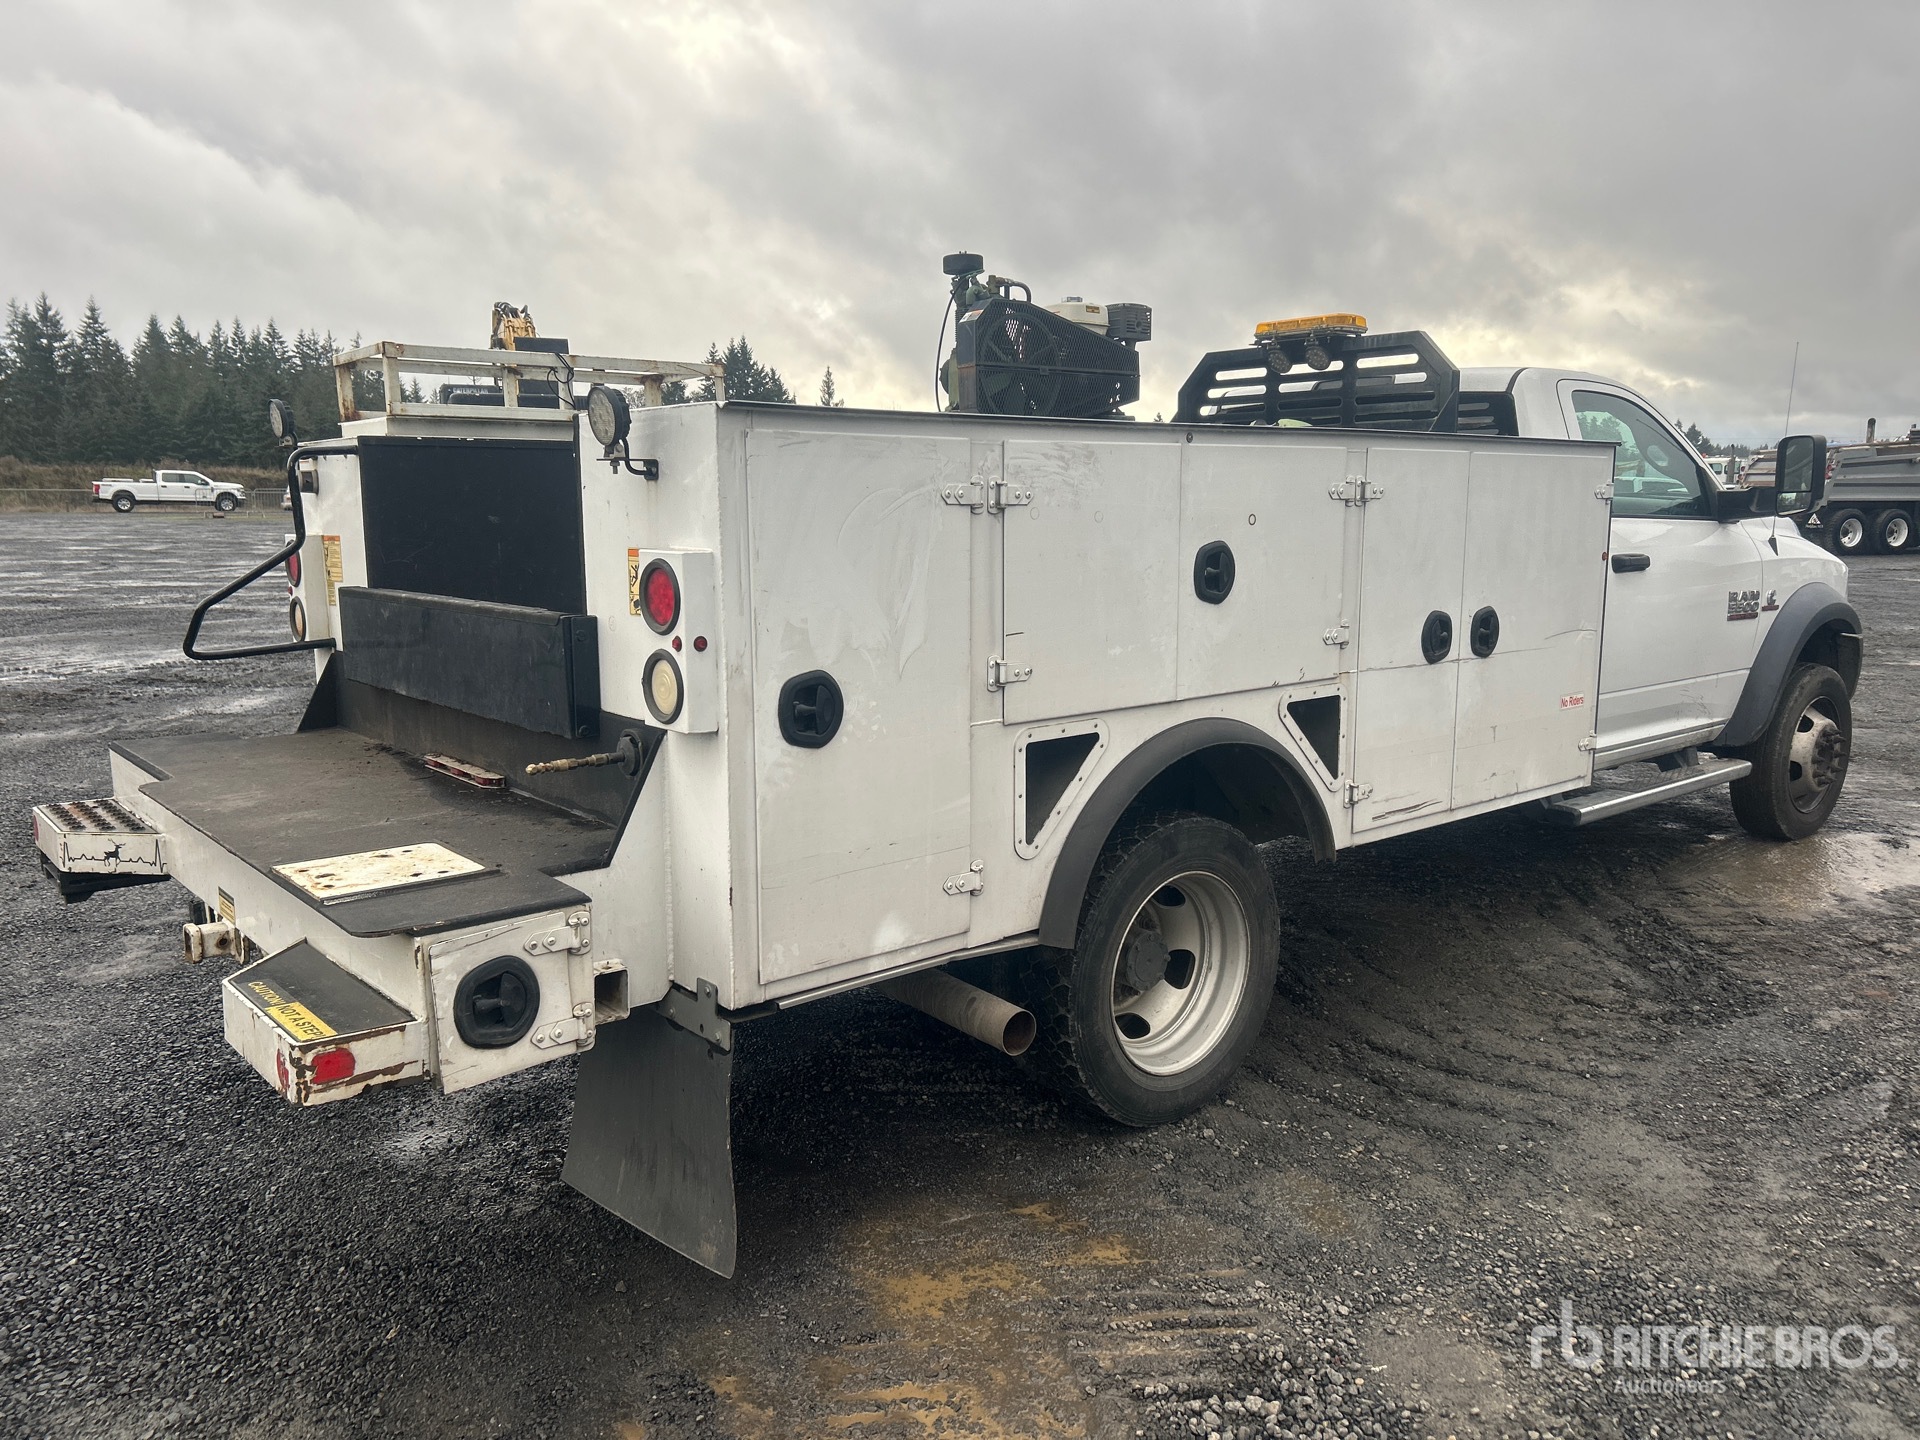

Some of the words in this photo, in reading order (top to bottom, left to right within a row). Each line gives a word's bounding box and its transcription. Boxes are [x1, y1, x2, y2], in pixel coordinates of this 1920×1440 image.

[1728, 590, 1760, 602] RAM
[1561, 698, 1568, 708] No
[1569, 696, 1584, 706] Riders
[276, 1004, 302, 1018] NOT
[289, 1016, 306, 1024] A
